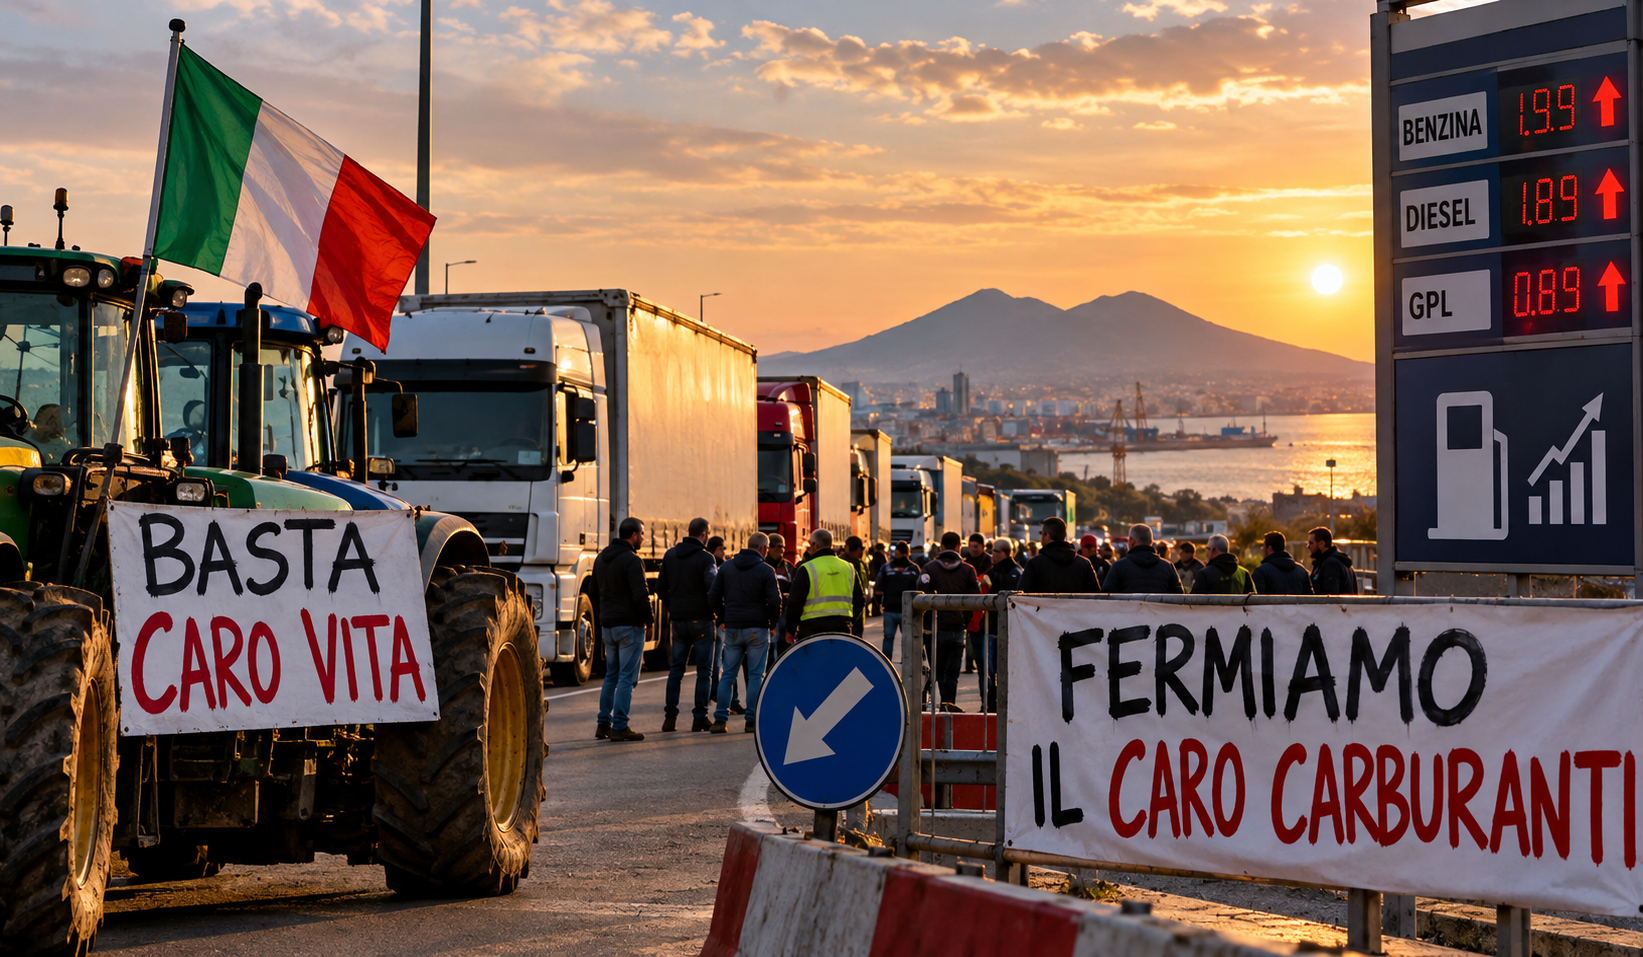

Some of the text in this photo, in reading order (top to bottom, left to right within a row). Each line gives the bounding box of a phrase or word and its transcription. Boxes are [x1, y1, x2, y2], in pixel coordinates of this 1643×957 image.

[1403, 108, 1482, 146] BENZINA
[1406, 198, 1475, 232] DIESEL
[1409, 290, 1452, 319] GPL
[139, 513, 380, 597] BASTA
[132, 608, 426, 714] CARO VITA
[1057, 622, 1487, 727] FERMIAMO
[1032, 738, 1637, 871] IL CARO CARBURANTI
